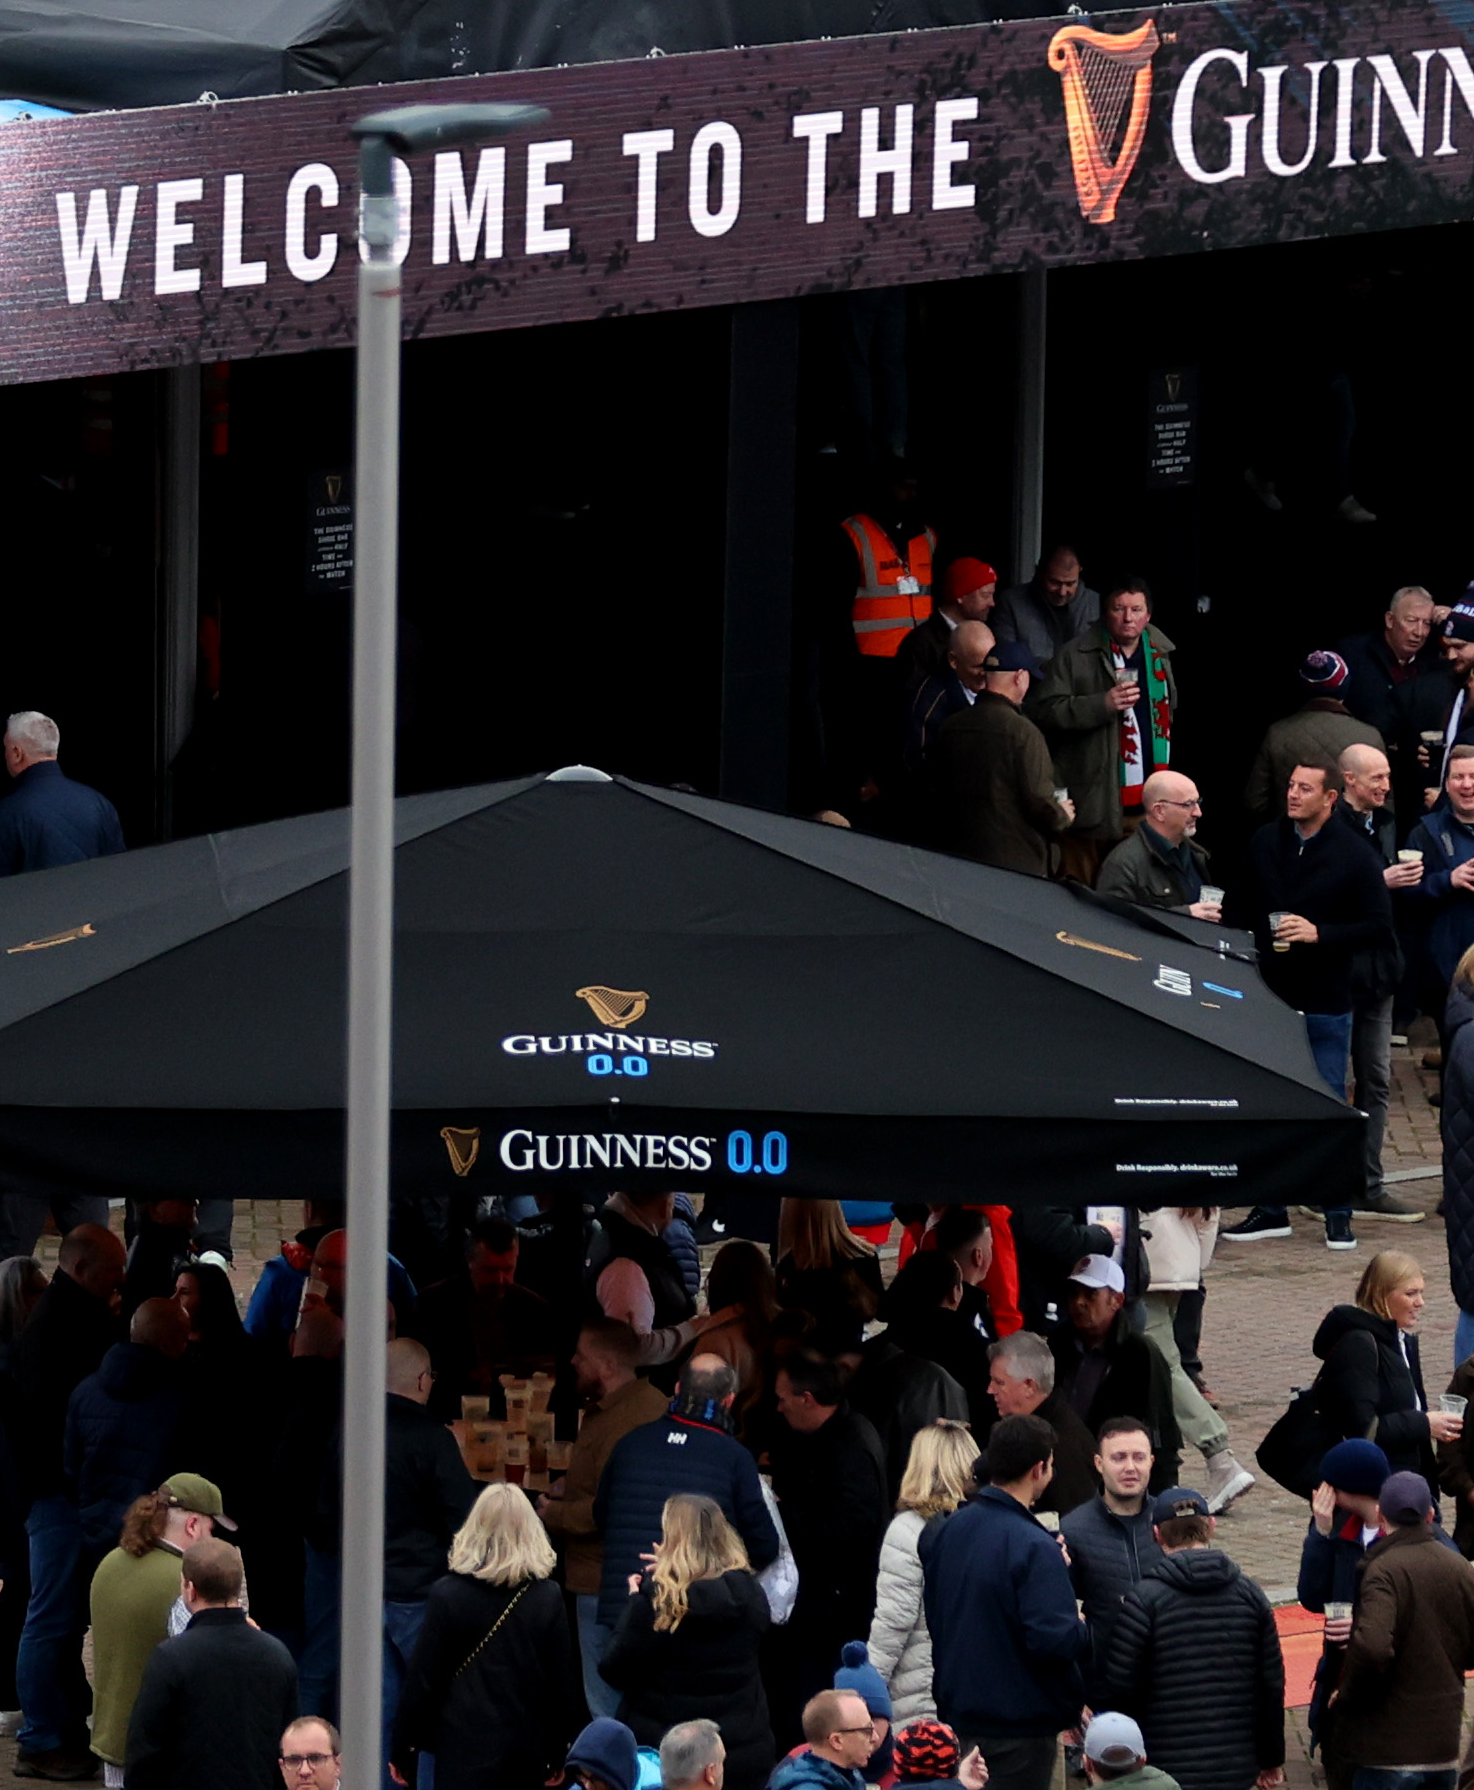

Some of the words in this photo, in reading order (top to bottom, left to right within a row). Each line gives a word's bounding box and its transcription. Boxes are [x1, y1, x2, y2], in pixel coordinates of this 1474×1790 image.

[622, 121, 741, 244] TO
[793, 96, 980, 225] THE
[501, 1032, 716, 1058] GUINNESS
[587, 1054, 649, 1077] 0.0
[500, 1129, 713, 1171] GUINNESS
[727, 1130, 789, 1175] 0.0
[1116, 1164, 1136, 1172] Drink
